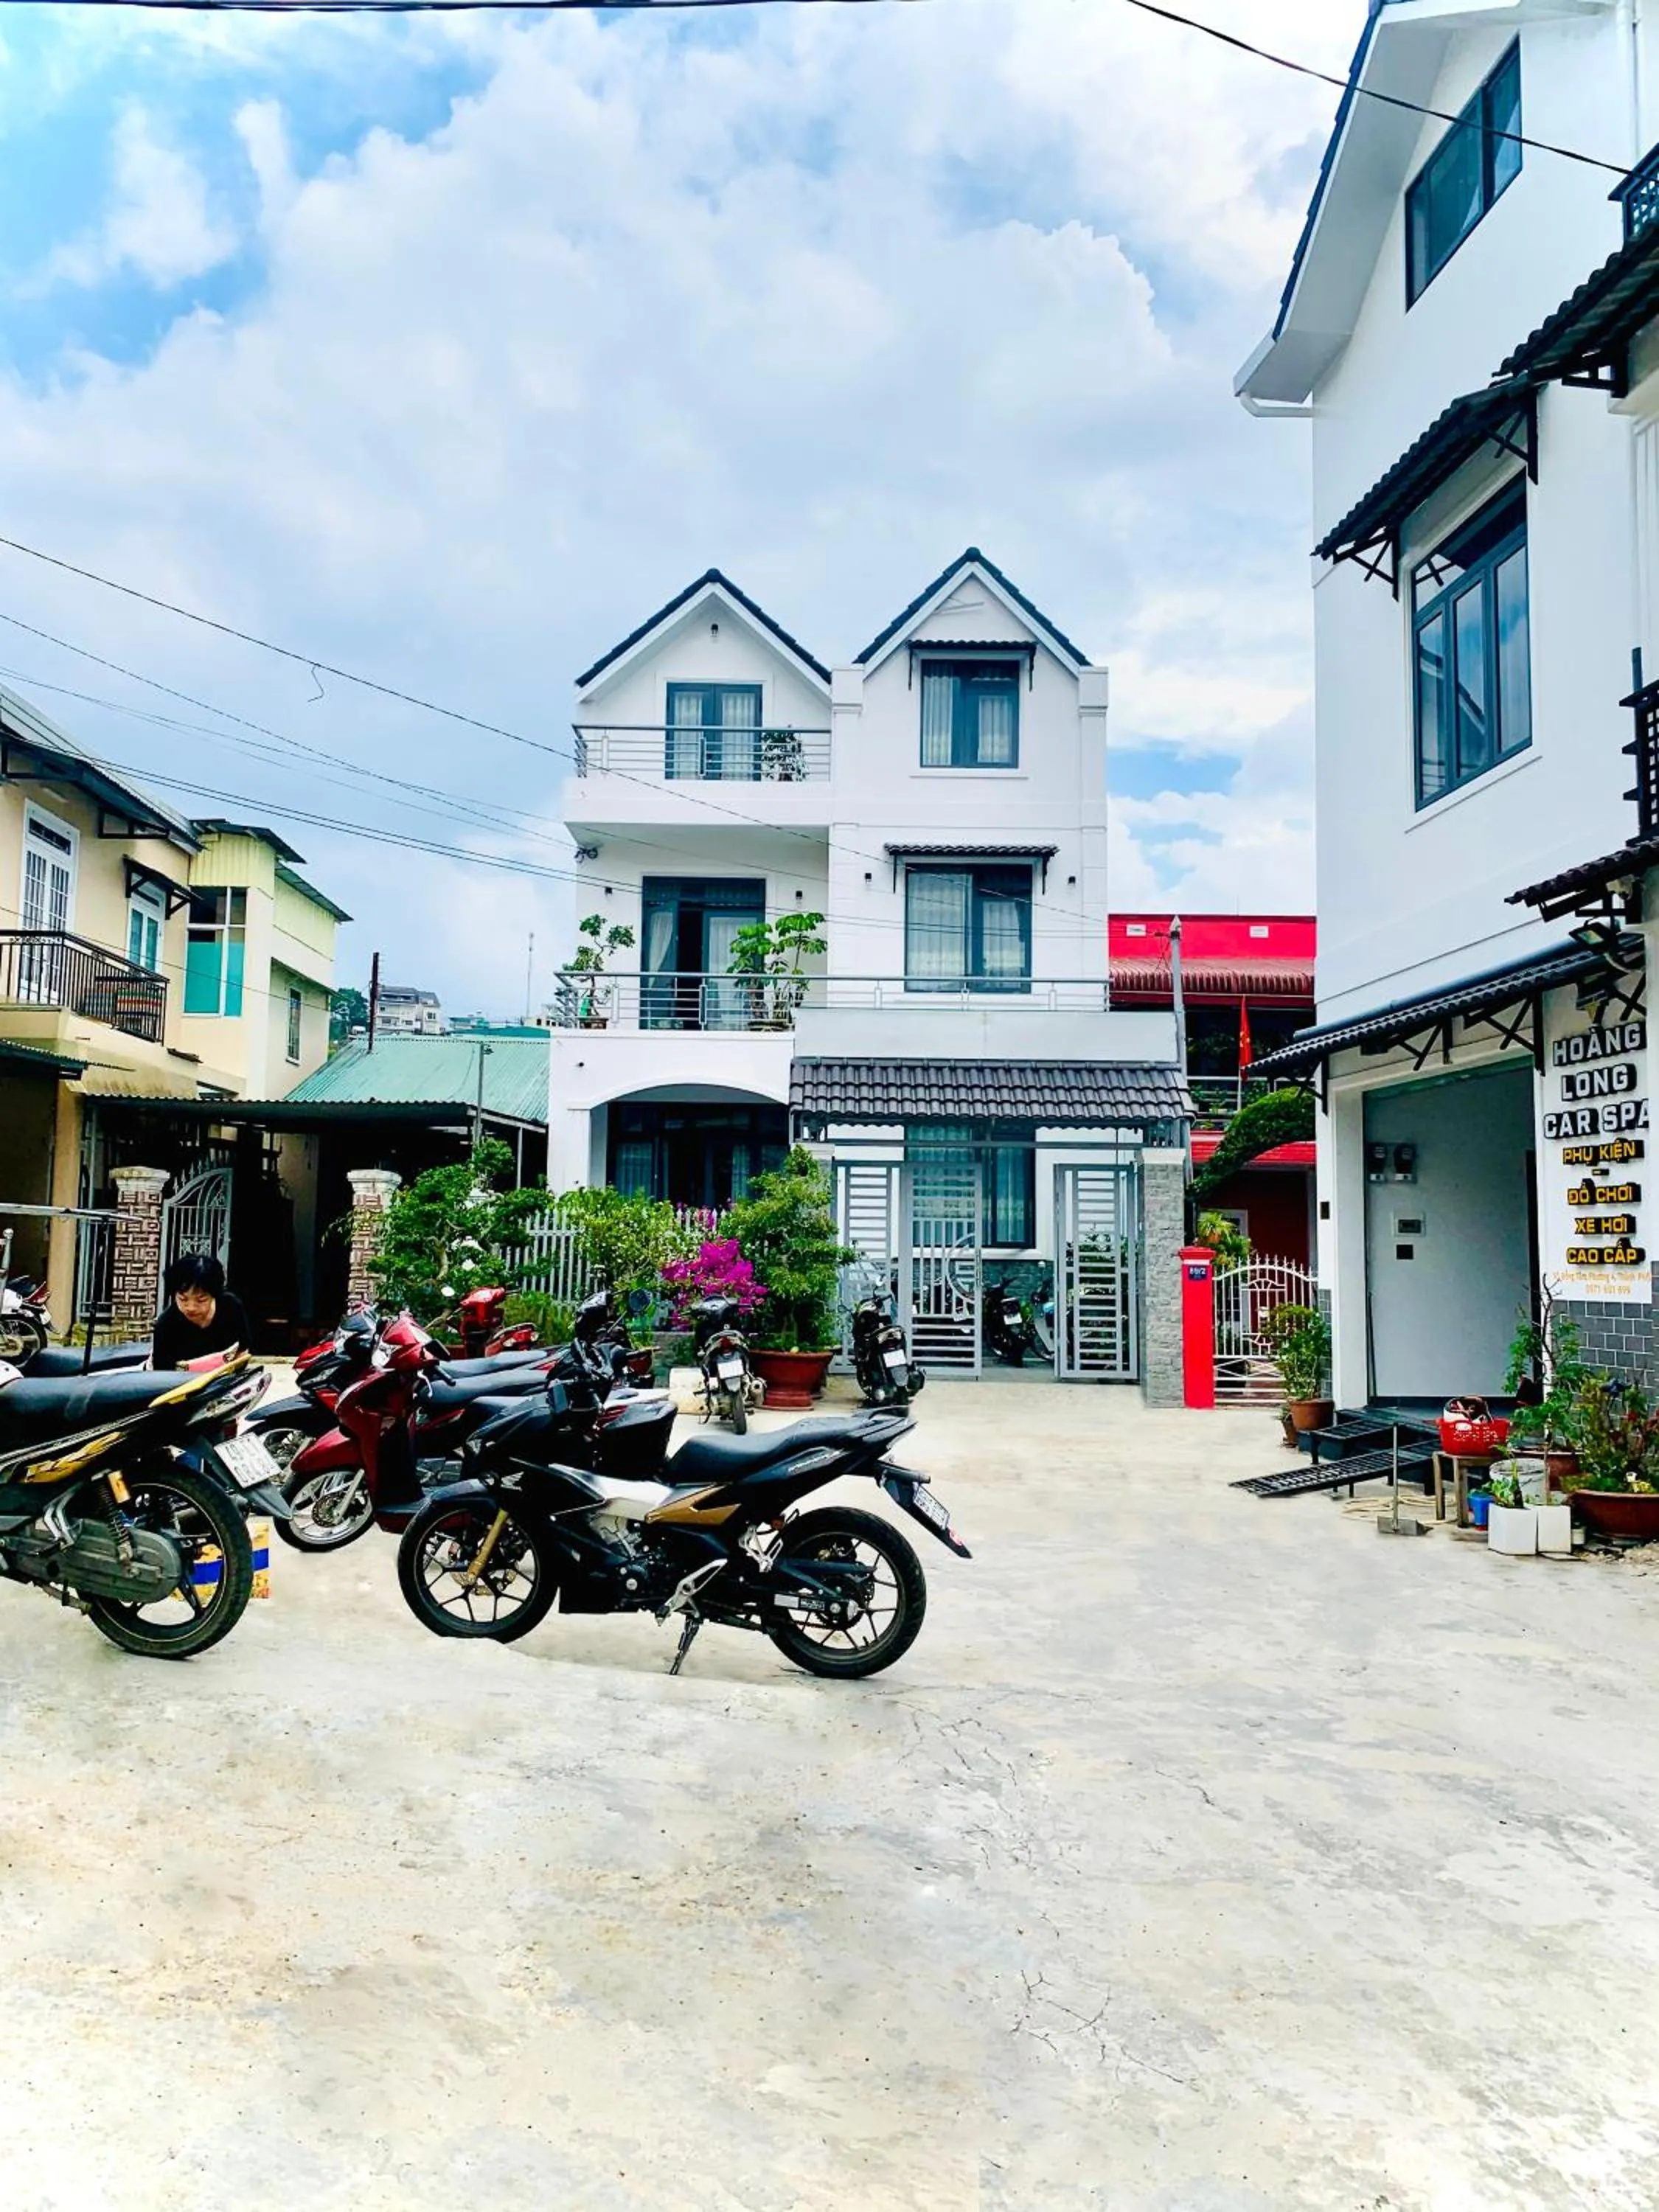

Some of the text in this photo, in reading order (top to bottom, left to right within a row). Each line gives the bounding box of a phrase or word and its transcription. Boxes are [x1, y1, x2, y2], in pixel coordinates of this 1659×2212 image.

[1554, 1023, 1642, 1066] HOÀNG
[1562, 1064, 1630, 1101] LONG
[1545, 1098, 1650, 1138] CAR SPA
[1563, 1139, 1636, 1166] PHỤ KIỆN
[1568, 1180, 1633, 1204] ĐỒ CHƠI
[1576, 1216, 1628, 1233] XE HƠI
[1568, 1248, 1599, 1264] CAO
